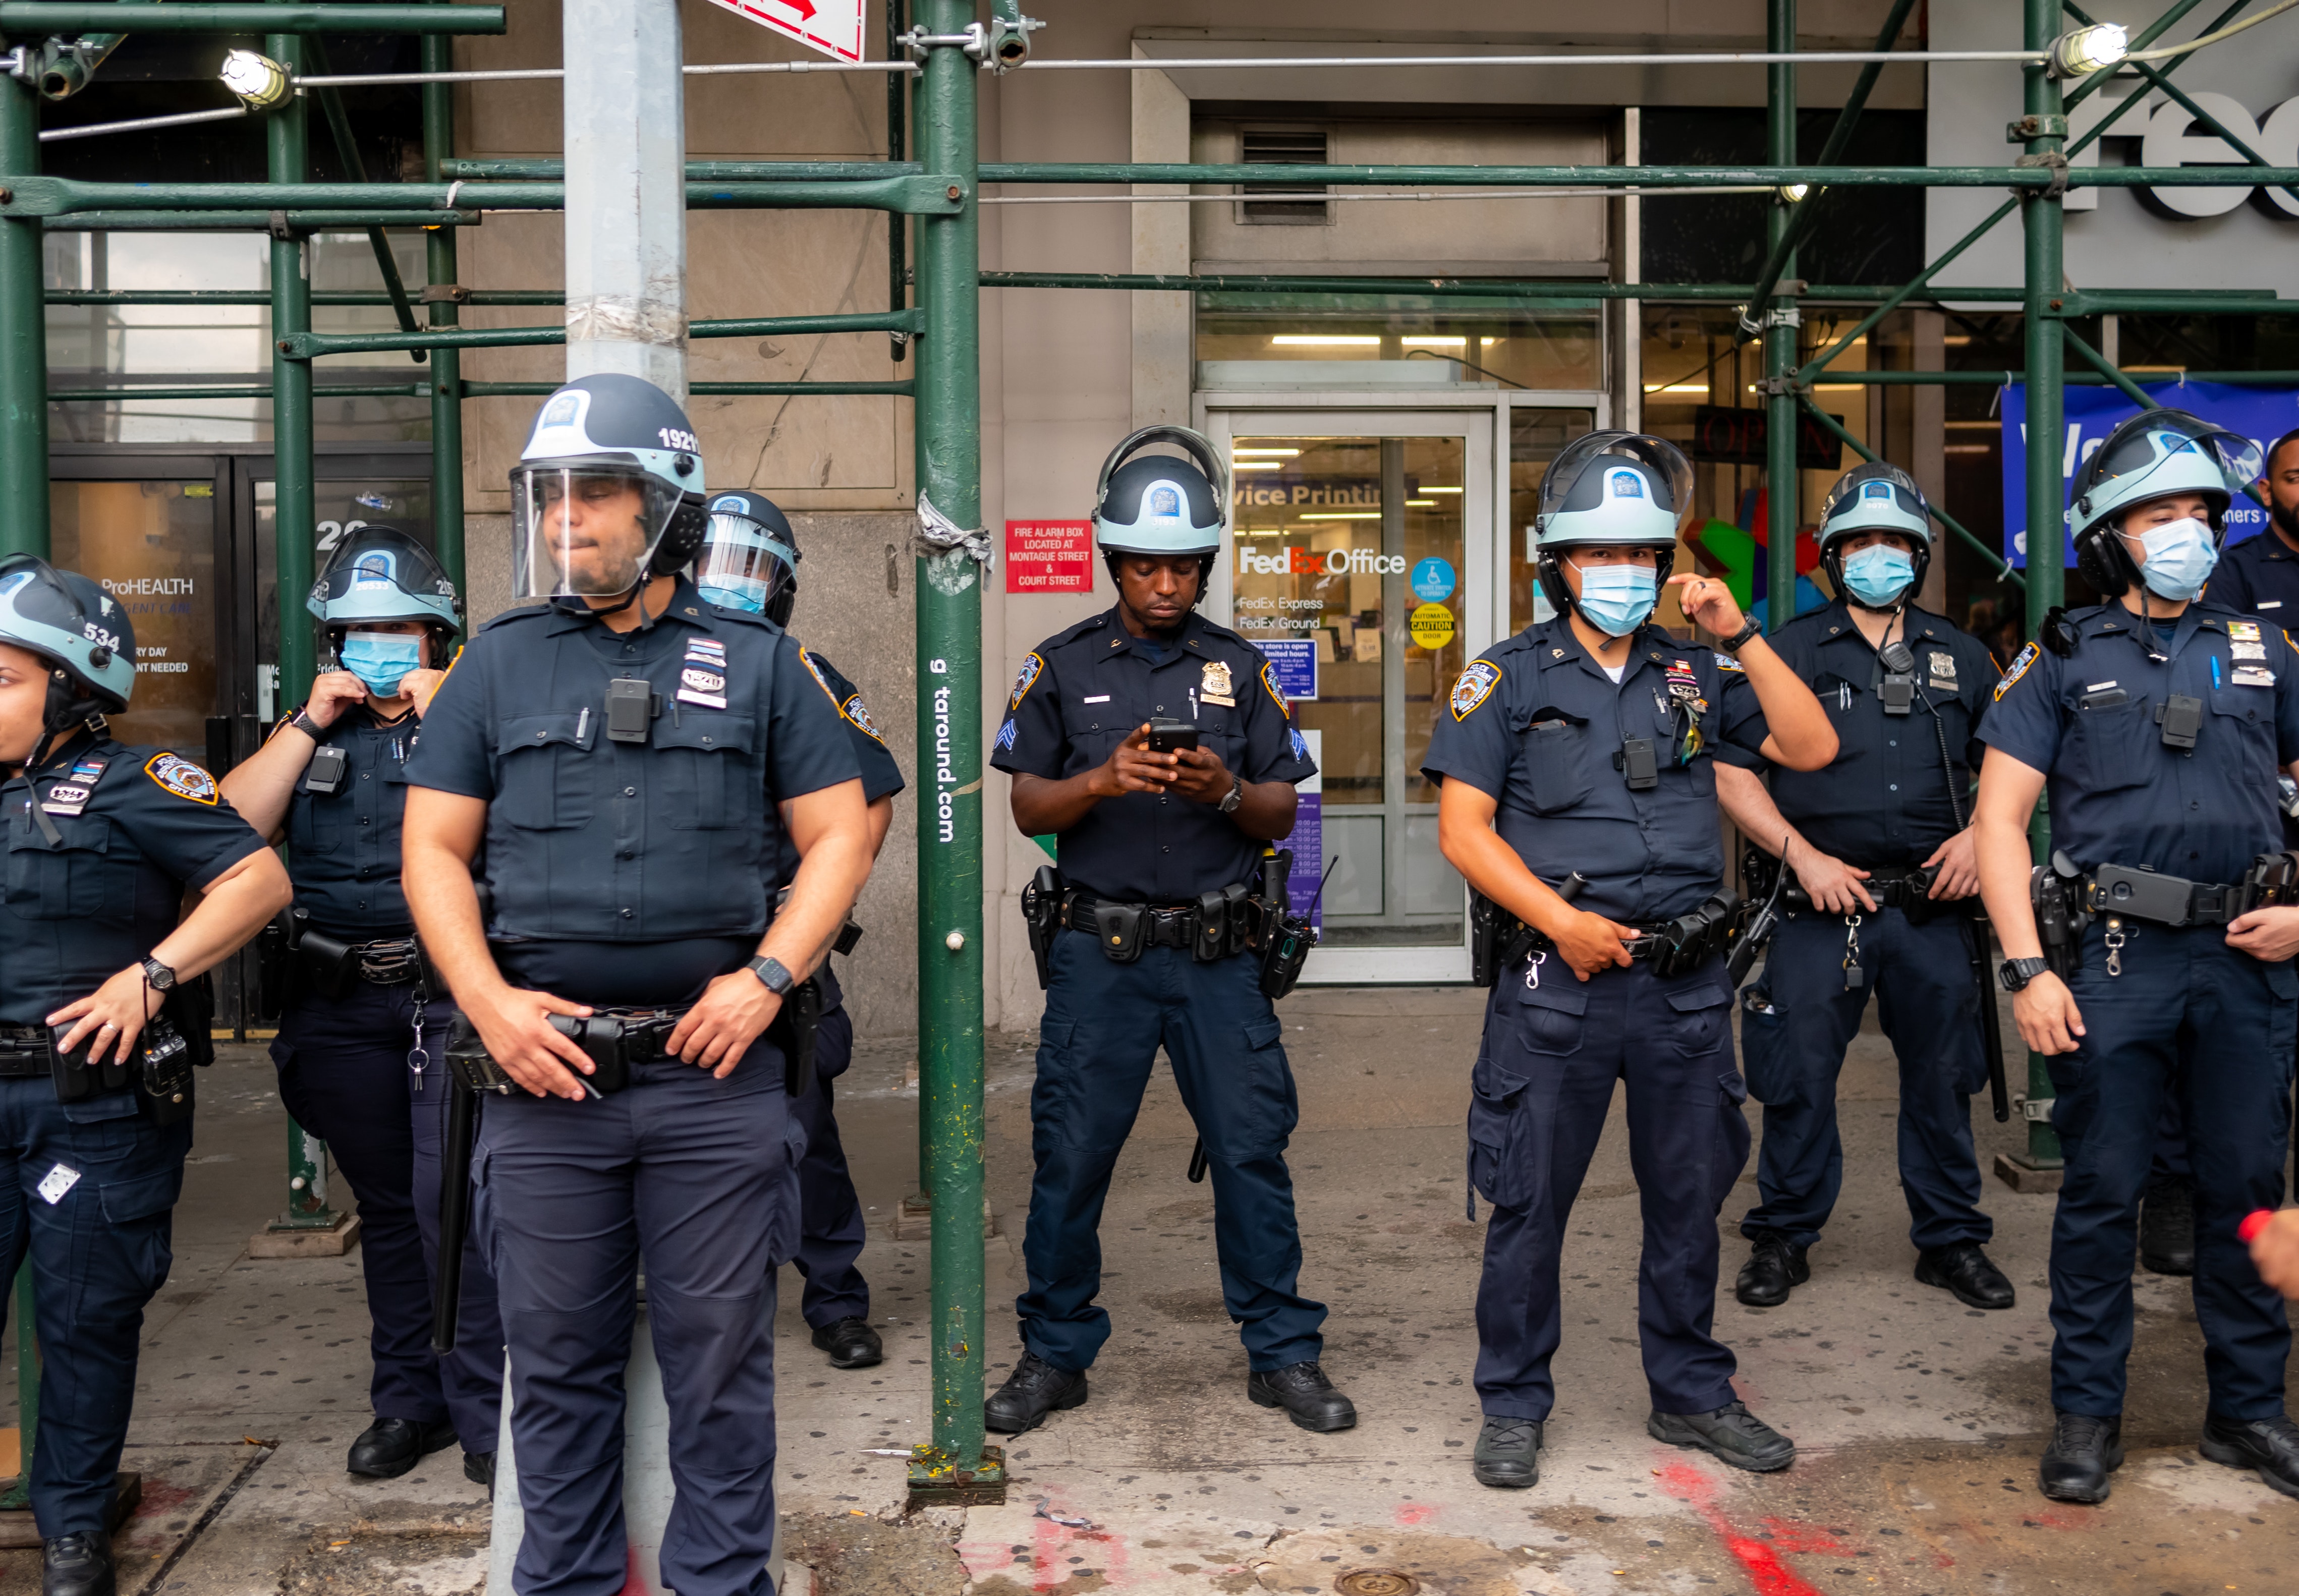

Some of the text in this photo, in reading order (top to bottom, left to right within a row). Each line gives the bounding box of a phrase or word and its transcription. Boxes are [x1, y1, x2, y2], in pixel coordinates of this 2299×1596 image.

[2062, 33, 2299, 217] Fe
[1703, 415, 1833, 463] OPN
[1015, 528, 1084, 537] FIRE ALARM BOX
[1025, 540, 1073, 549] LOCATED AT
[1010, 552, 1089, 561] MONTAGUE STREET
[1240, 547, 1406, 574] FedEx Office
[1046, 564, 1053, 573] &
[1019, 576, 1080, 585] COURT STREET
[102, 578, 193, 595] ProHEALTH
[1240, 597, 1323, 611] FedEx Express
[1240, 617, 1320, 630] FedEx Ground
[1411, 621, 1451, 630] CAUTION
[83, 622, 120, 653] 534
[148, 647, 167, 657] DAY
[151, 662, 188, 672] NEEDED
[168, 783, 188, 794] CITY
